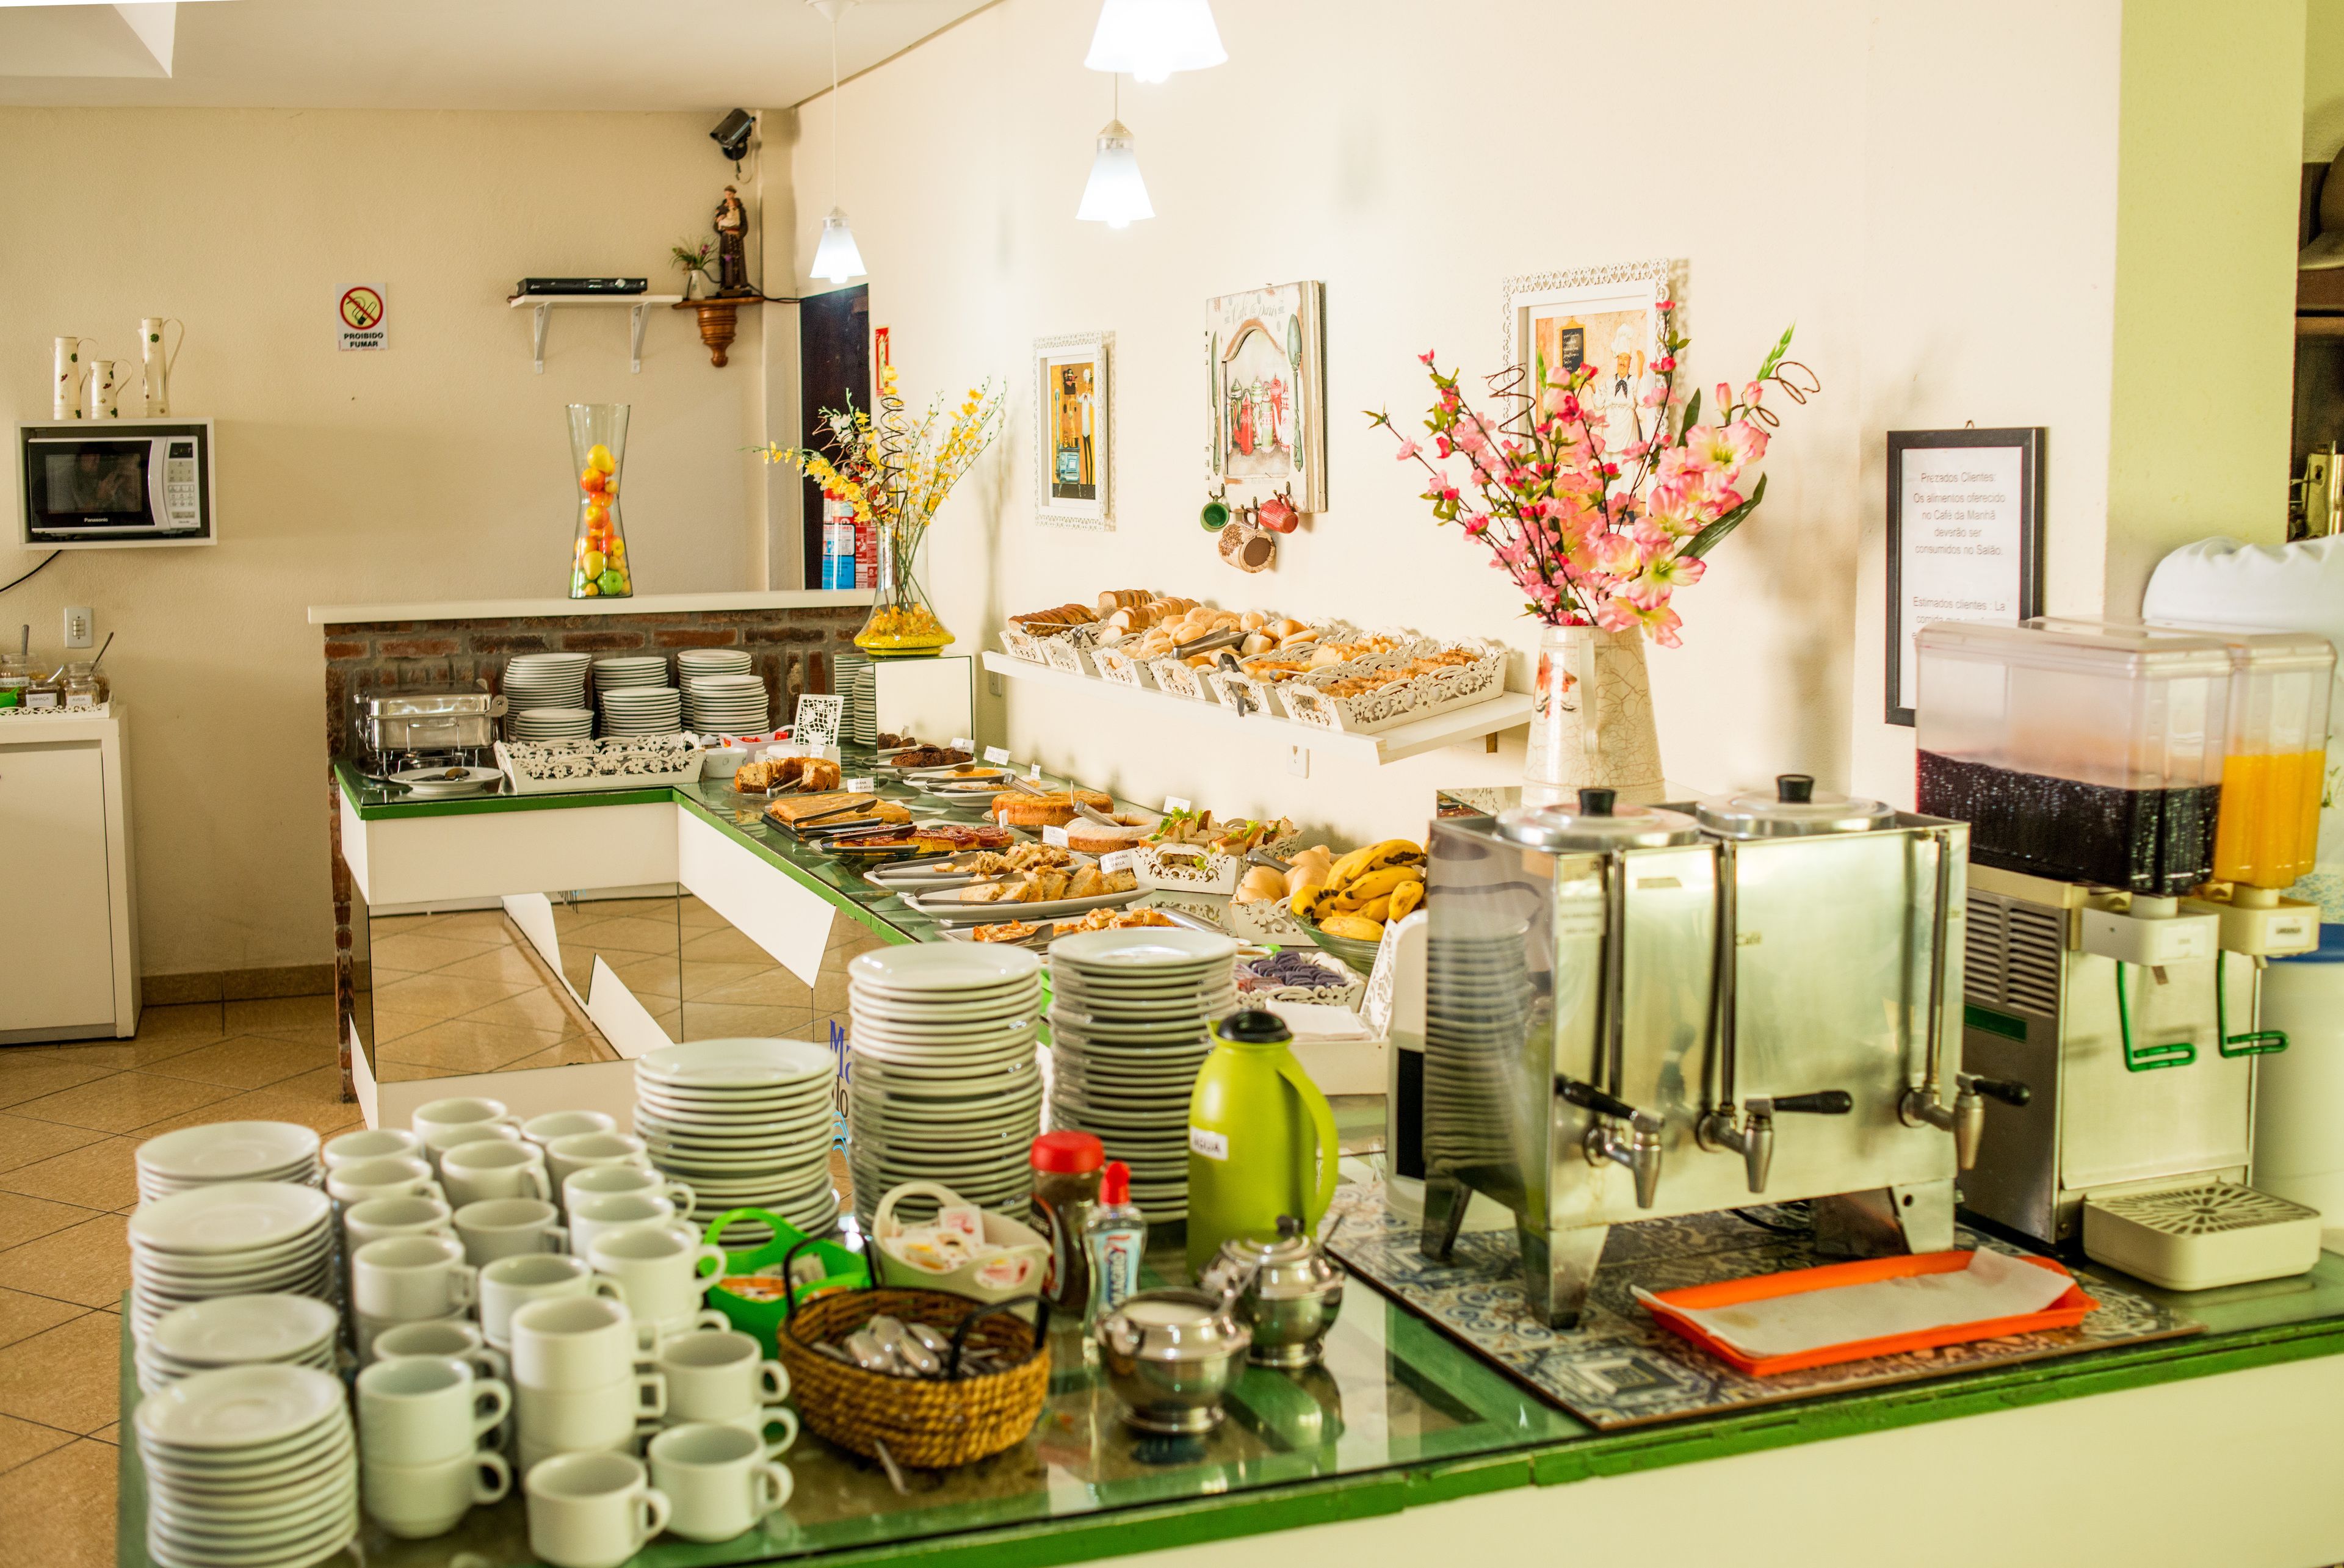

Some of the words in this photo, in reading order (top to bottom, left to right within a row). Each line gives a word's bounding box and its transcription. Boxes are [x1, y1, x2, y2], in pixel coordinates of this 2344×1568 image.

[1257, 302, 1277, 318] Paris
[1921, 472, 1958, 483] Prezados
[1961, 471, 1997, 482] Clientes:
[1914, 493, 1924, 503] Os
[1926, 493, 1964, 503] alimentos
[1922, 511, 1931, 520] no
[1934, 510, 1952, 520] Café
[1955, 510, 1964, 520] da
[1967, 510, 1996, 520] Manhã
[1934, 527, 1966, 537] deverão
[1969, 529, 1982, 538] ser
[1915, 544, 1961, 555] consumidos
[1963, 546, 1973, 555] no
[1913, 596, 1953, 608] Estimados
[1955, 599, 1987, 610] clientes
[1994, 601, 2006, 611] La
